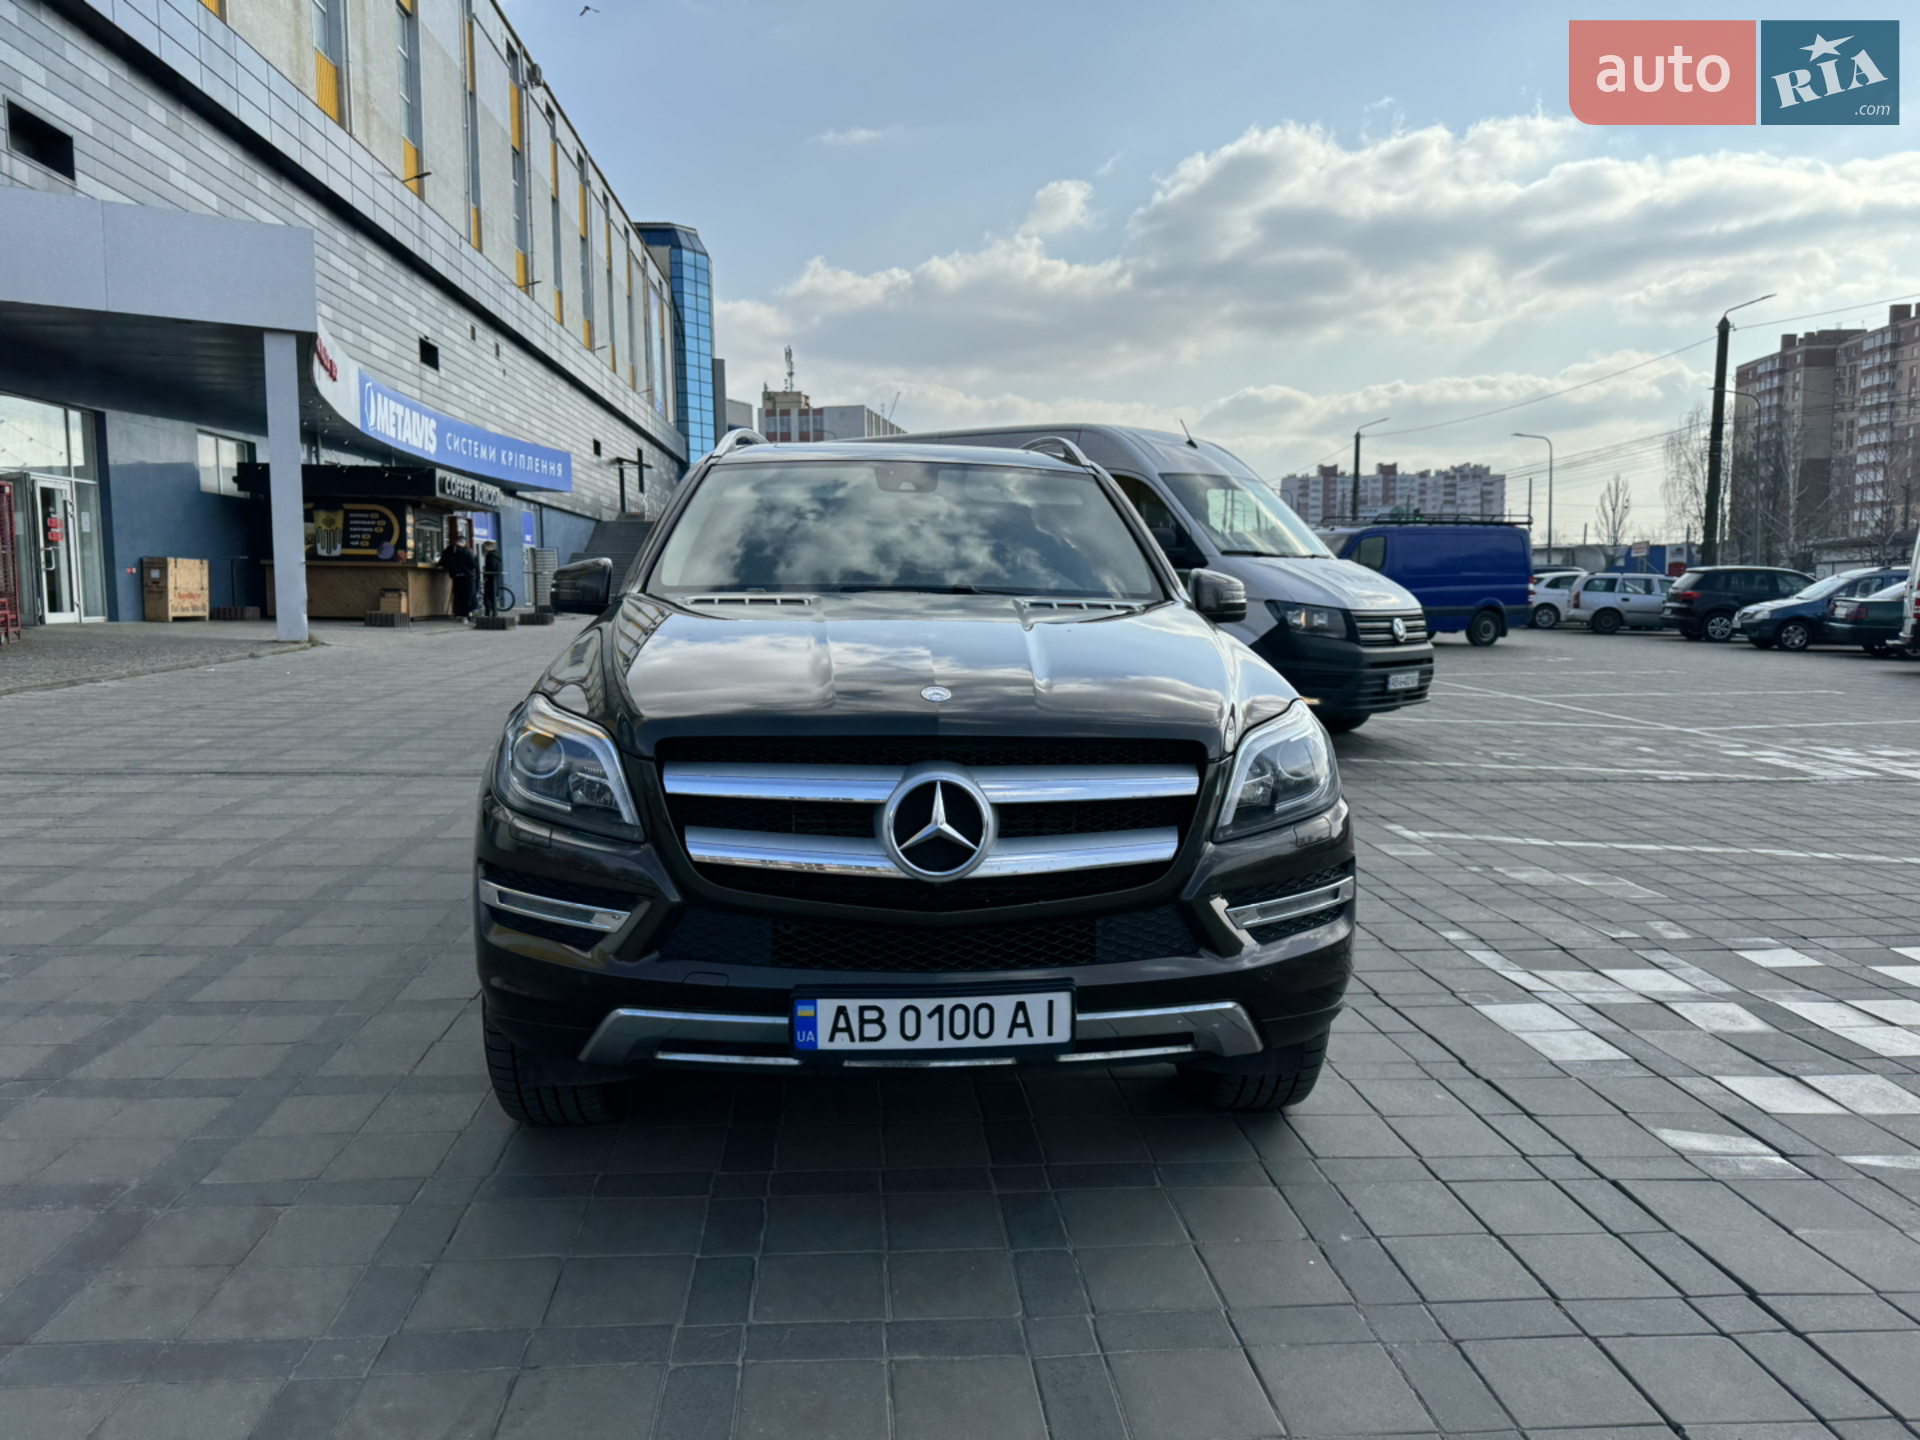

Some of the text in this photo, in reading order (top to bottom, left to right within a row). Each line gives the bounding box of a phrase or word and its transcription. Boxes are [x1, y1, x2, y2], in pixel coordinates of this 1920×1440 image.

[376, 391, 437, 454] METALVIS
[446, 432, 563, 478] СИСТЕМИ КРІПЛЕННЯ
[445, 475, 472, 500] COFFEE
[796, 1031, 816, 1042] UA
[828, 1005, 887, 1043] AB
[899, 1002, 995, 1041] 0100
